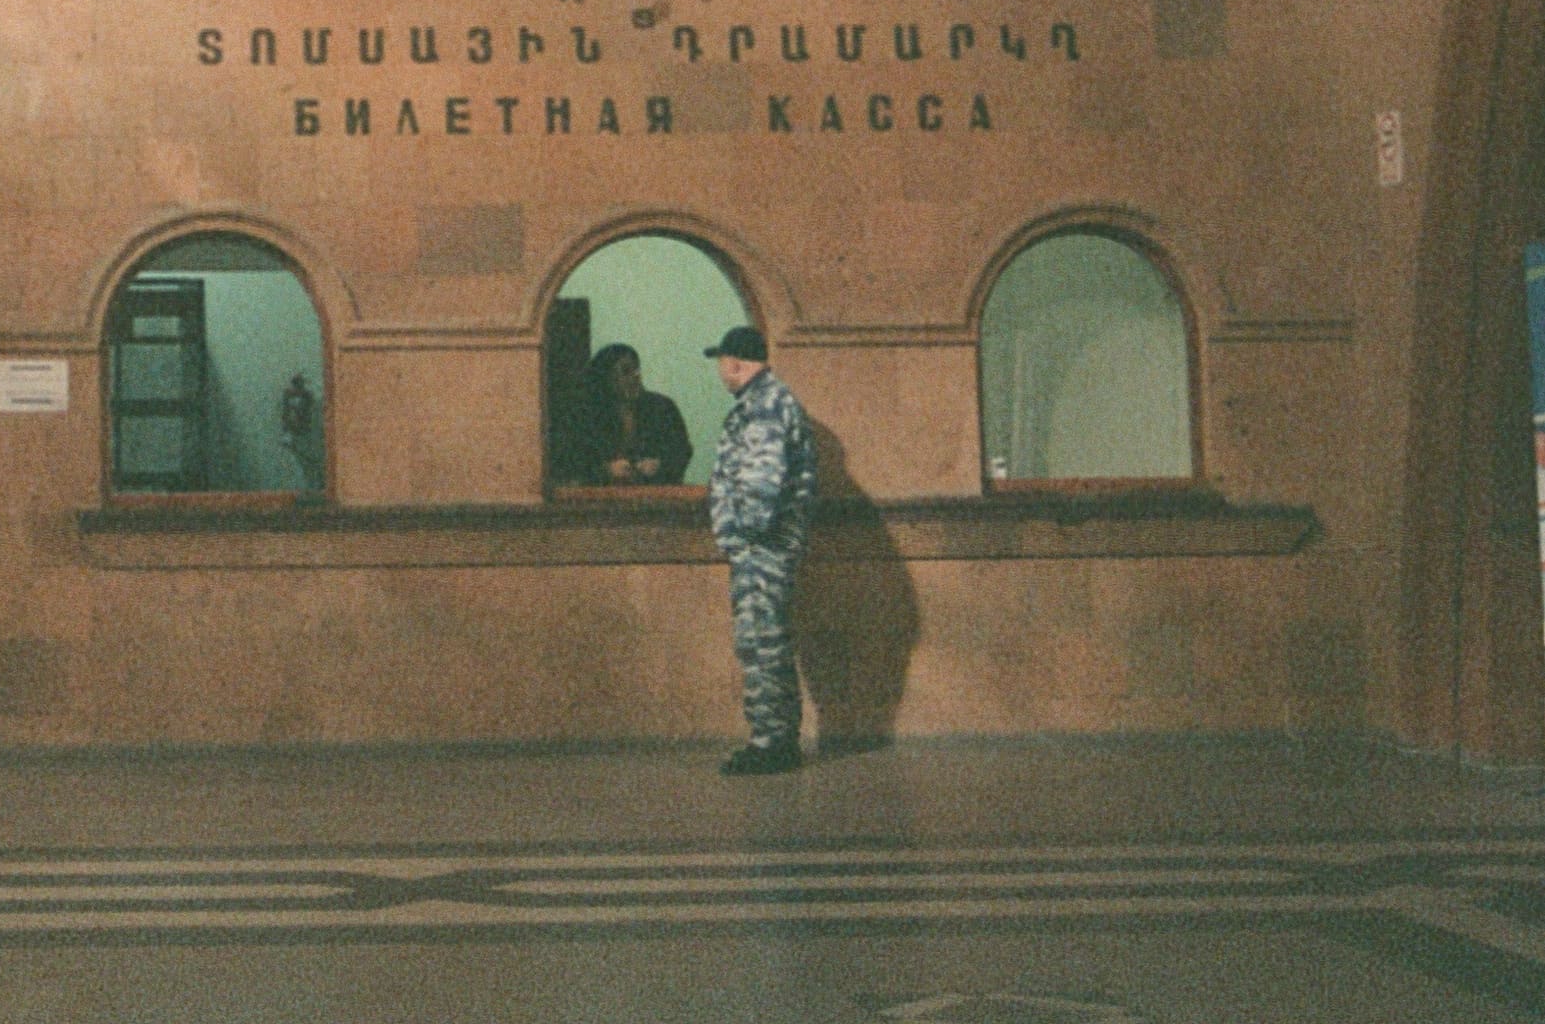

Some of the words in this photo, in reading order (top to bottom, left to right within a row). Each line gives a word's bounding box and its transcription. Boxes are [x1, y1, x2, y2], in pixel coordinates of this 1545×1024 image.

[197, 26, 603, 66] ՏՈՄՍԱՅԻՆ
[673, 23, 1082, 63] ԴՐԱՄԱՐԿՂ
[294, 96, 673, 137] БИЛЕТНАЯ
[768, 93, 993, 133] КАССА
